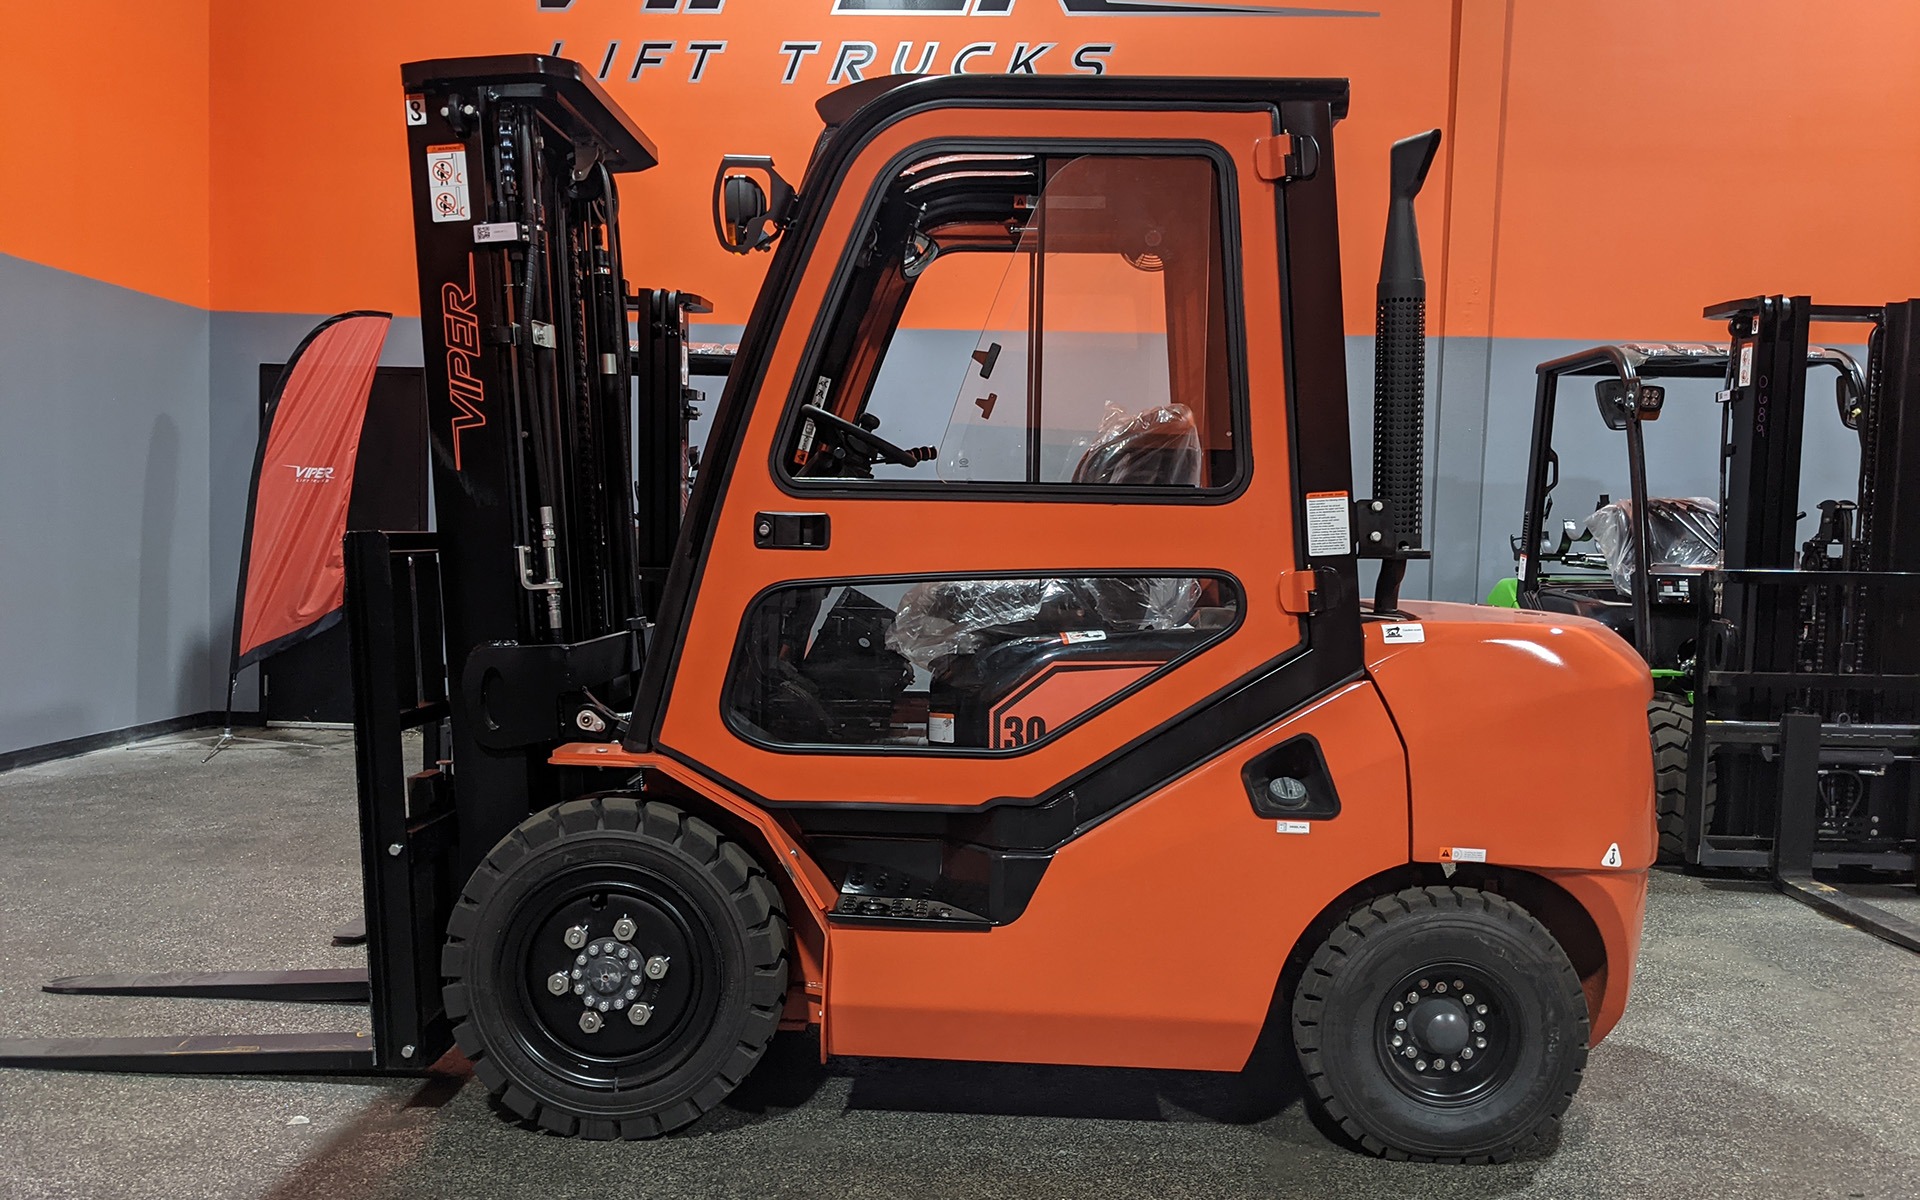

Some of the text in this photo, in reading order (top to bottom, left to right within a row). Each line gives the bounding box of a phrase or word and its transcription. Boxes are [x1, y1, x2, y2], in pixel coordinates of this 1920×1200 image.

[778, 41, 1116, 84] TRUCKS
[441, 251, 487, 472] VIPER
[281, 464, 337, 479] VIPER
[1004, 716, 1046, 749] 30
